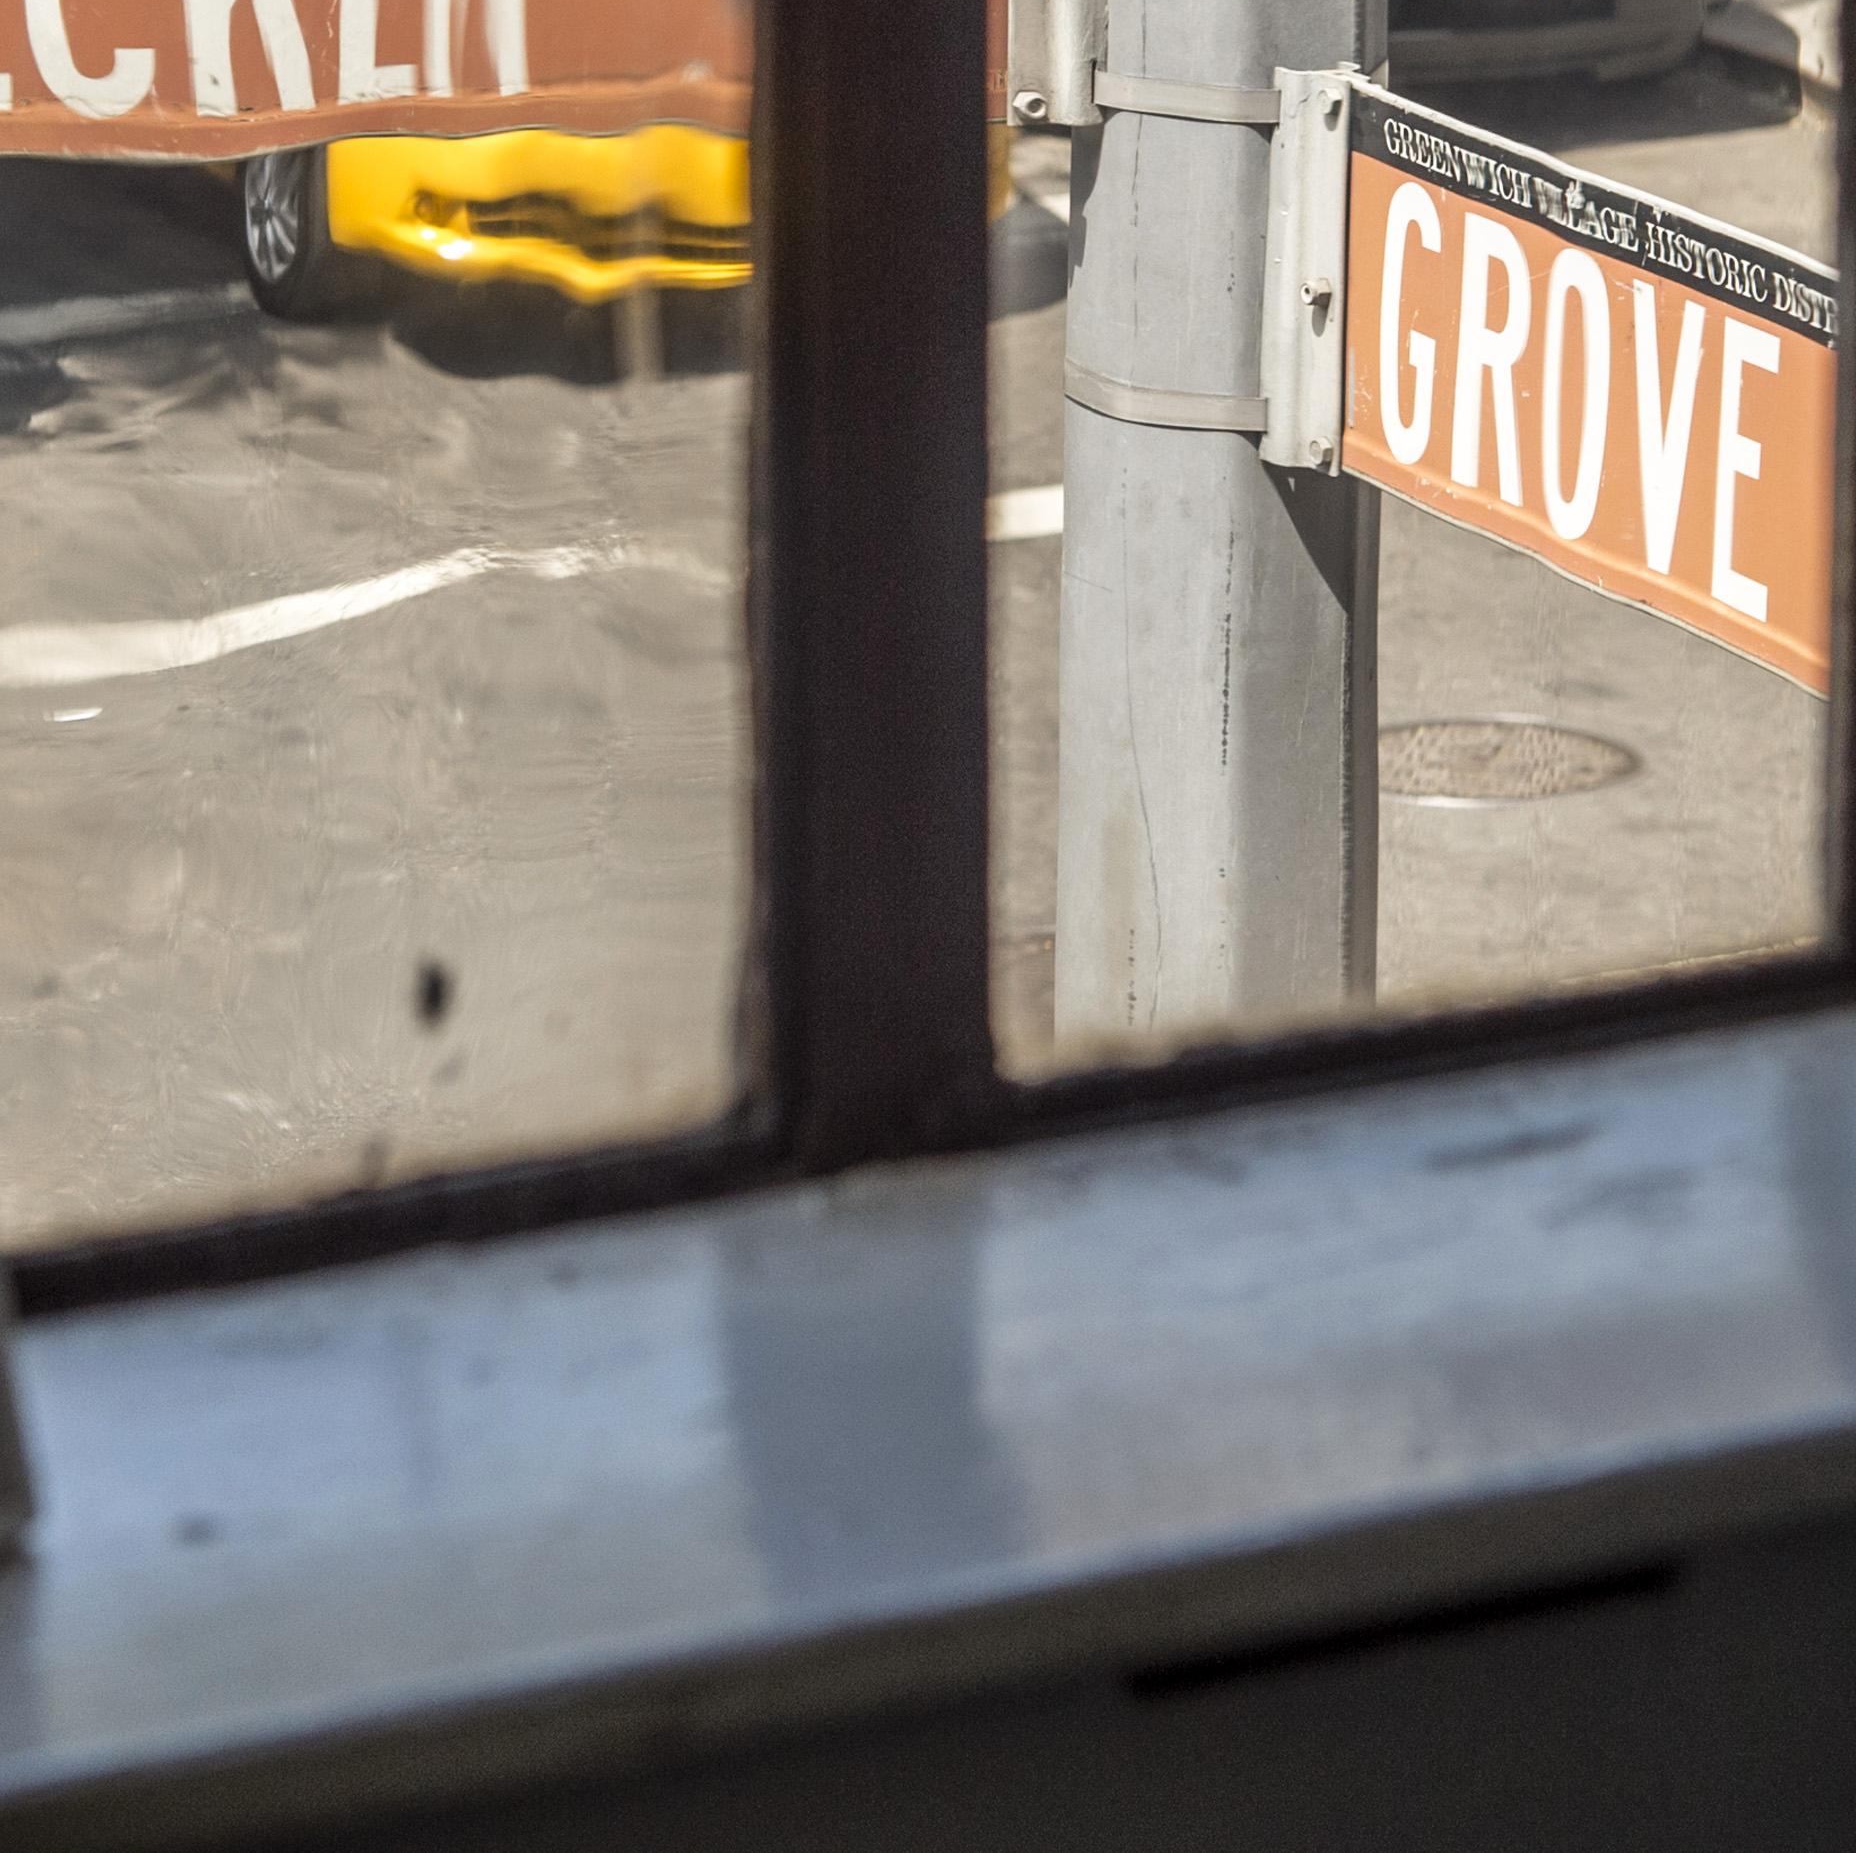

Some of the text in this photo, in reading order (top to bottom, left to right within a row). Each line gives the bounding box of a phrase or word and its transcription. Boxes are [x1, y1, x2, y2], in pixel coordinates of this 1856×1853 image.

[1383, 118, 1532, 208] GREENWICH
[1646, 221, 1768, 303] HISTORIC
[1772, 272, 1839, 335] DISTR
[1380, 181, 1780, 623] GROVE
